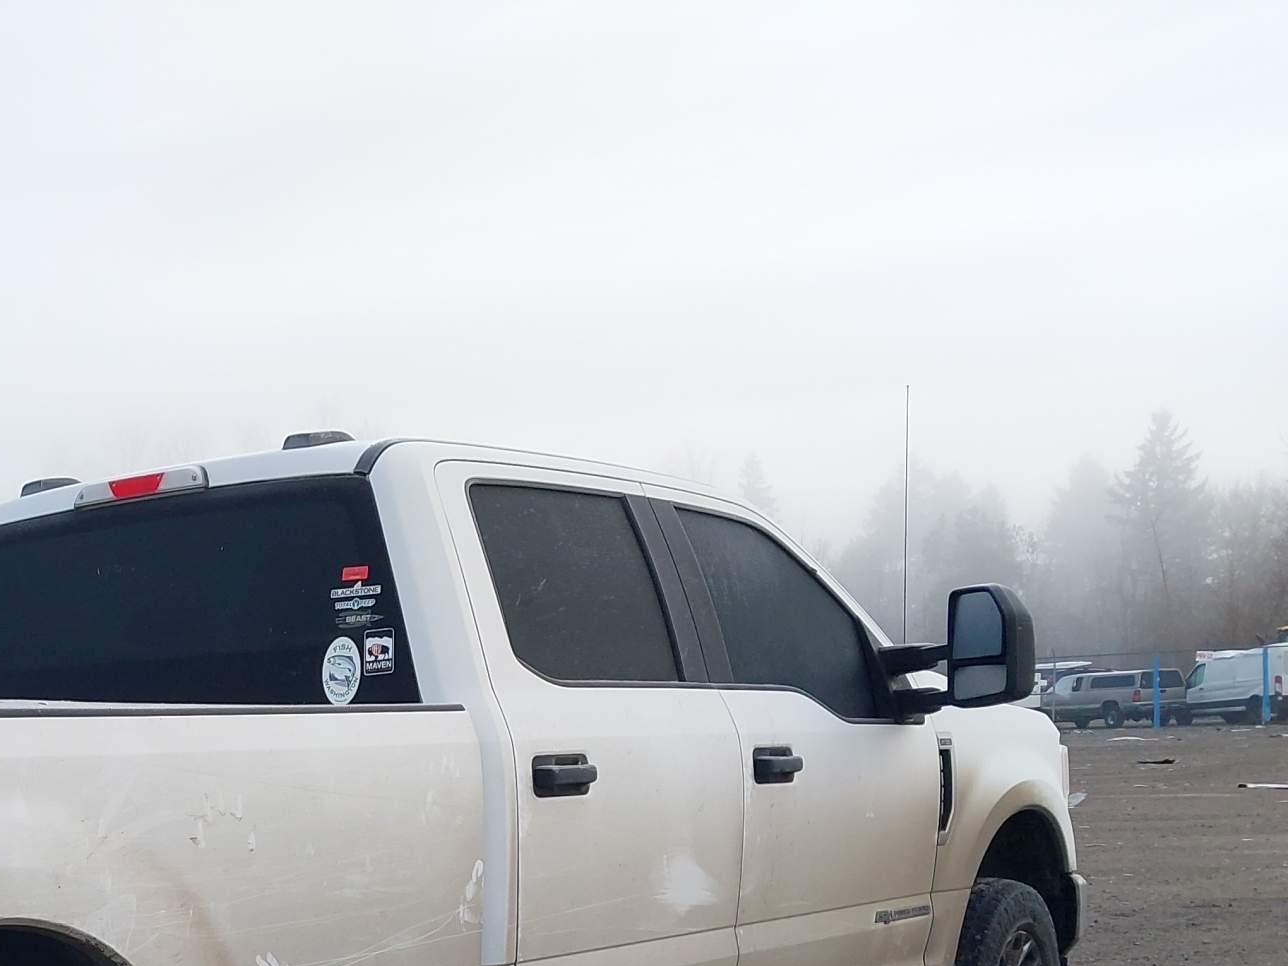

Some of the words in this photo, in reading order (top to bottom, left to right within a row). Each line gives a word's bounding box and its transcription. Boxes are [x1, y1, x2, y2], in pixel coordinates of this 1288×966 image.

[332, 586, 379, 597] BLACKSTONE
[346, 615, 371, 623] BEAST
[333, 644, 352, 653] FISH
[366, 661, 392, 670] MAVEN
[324, 677, 358, 699] WASHINGTON
